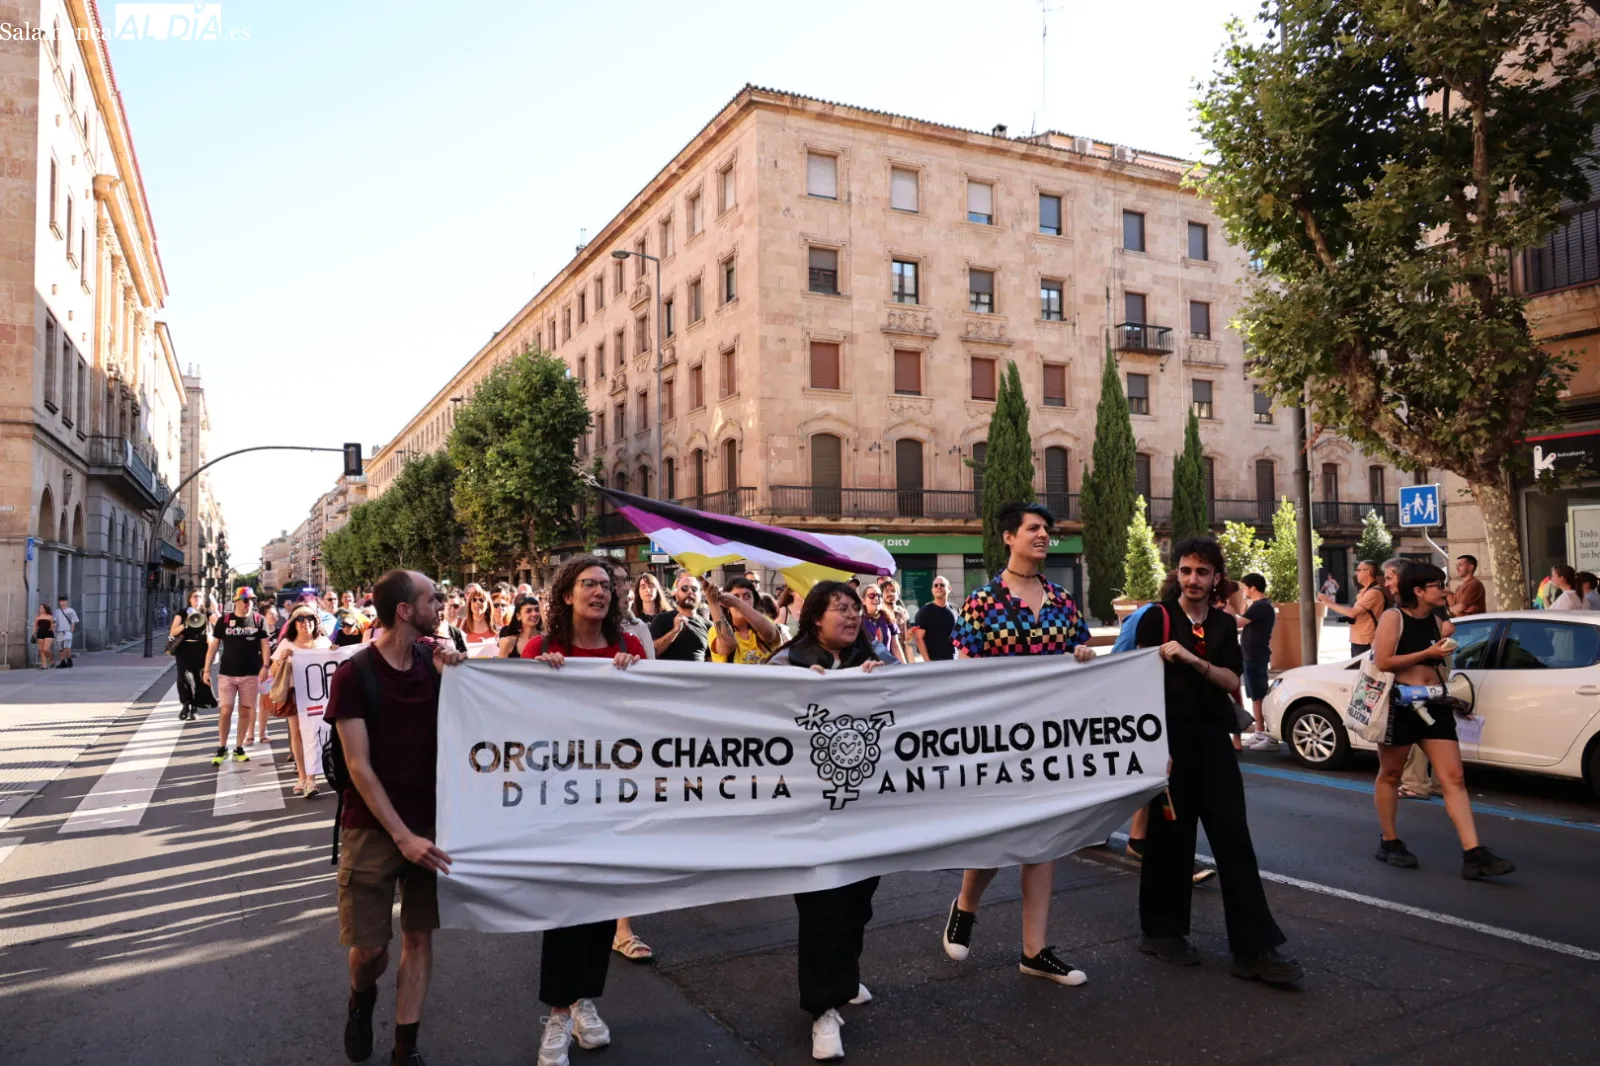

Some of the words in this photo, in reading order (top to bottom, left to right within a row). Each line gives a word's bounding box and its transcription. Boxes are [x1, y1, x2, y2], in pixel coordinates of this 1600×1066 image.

[887, 538, 910, 546] DKV
[1579, 529, 1598, 538] Todo
[1580, 540, 1599, 549] hasta
[895, 722, 1035, 761] ORGULLO
[1043, 713, 1163, 749] DIVERSO
[468, 738, 643, 773] ORGULLO
[652, 736, 794, 768] CHARRO
[878, 751, 1144, 794] ANTIFASCISTA
[502, 775, 792, 807] DISIDENCIA
